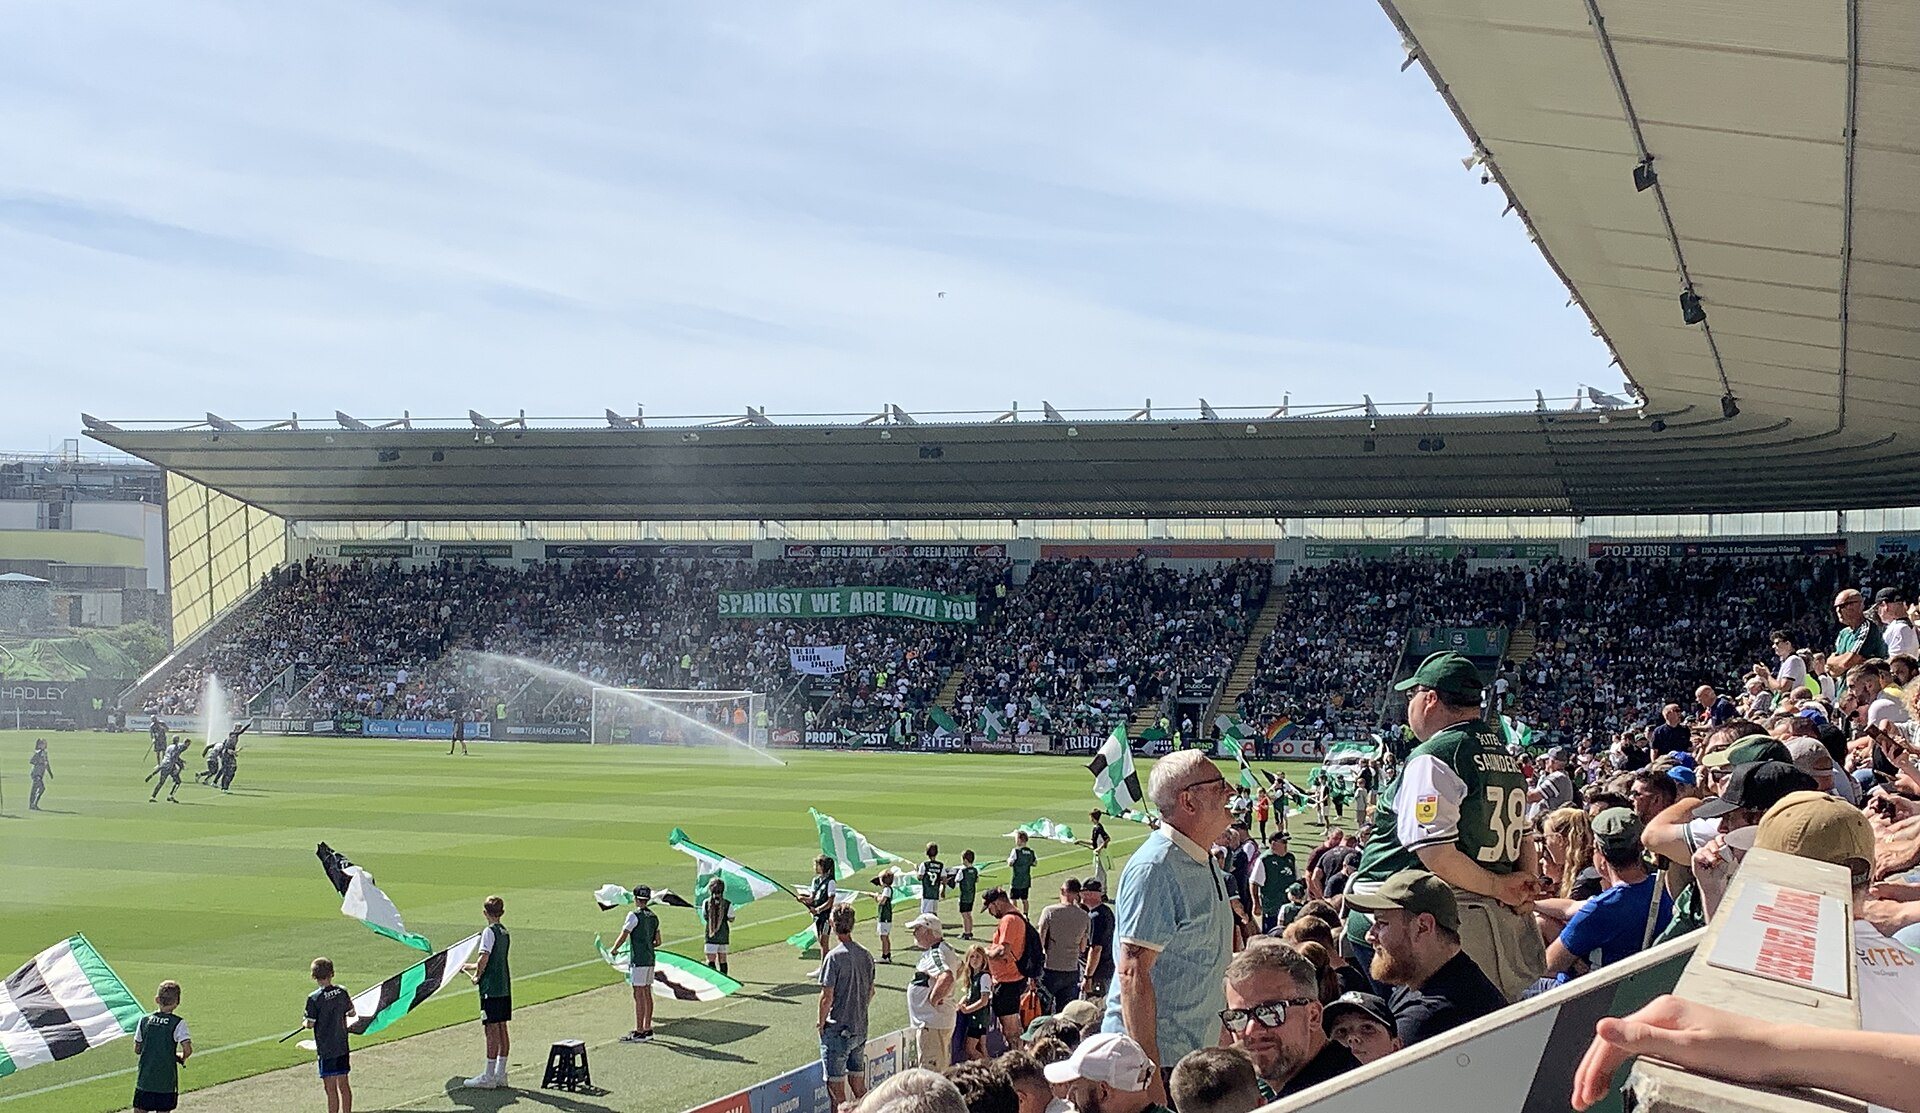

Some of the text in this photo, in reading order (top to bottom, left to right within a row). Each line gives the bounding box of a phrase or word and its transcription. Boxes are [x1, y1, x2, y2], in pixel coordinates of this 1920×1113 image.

[316, 547, 338, 556] MLT
[415, 547, 438, 556] MLT
[850, 547, 874, 557] ARMY
[913, 547, 969, 557] GREEN ARMY
[1603, 545, 1670, 557] TOP BINS!
[718, 592, 977, 621] SPARKSY WE ARE WITH YOU
[1, 687, 67, 700] HADLEY
[291, 720, 306, 731] POST
[1477, 785, 1526, 862] 38
